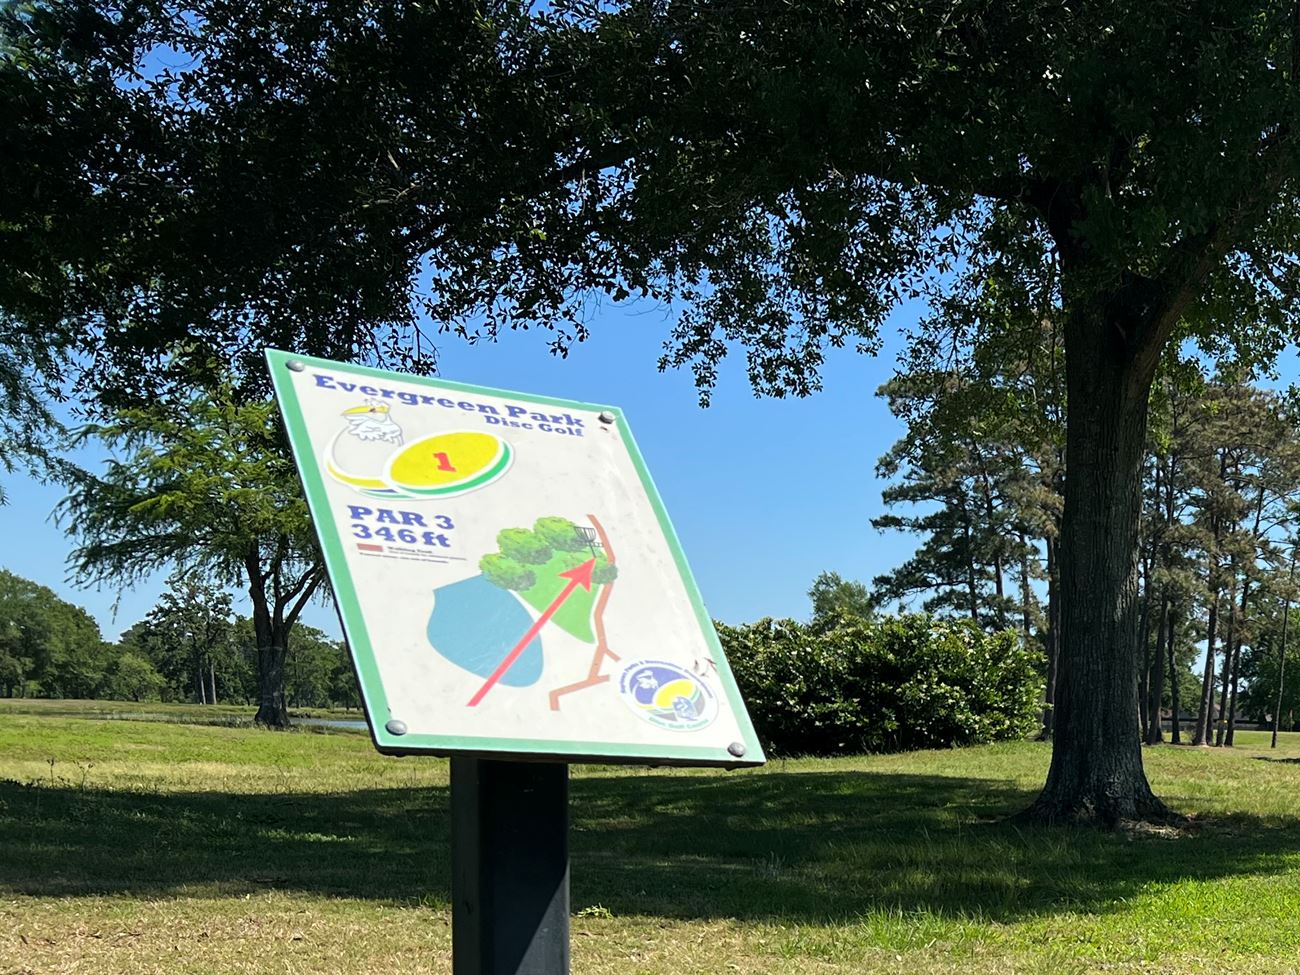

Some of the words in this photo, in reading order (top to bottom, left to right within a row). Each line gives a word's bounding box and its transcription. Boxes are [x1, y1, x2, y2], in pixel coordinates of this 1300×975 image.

[312, 373, 500, 415] Evergreen
[504, 404, 585, 428] Park
[484, 414, 533, 430] Disc
[538, 422, 584, 437] Golf
[432, 451, 457, 473] 1
[347, 504, 428, 528] PAR
[434, 514, 455, 531] 3
